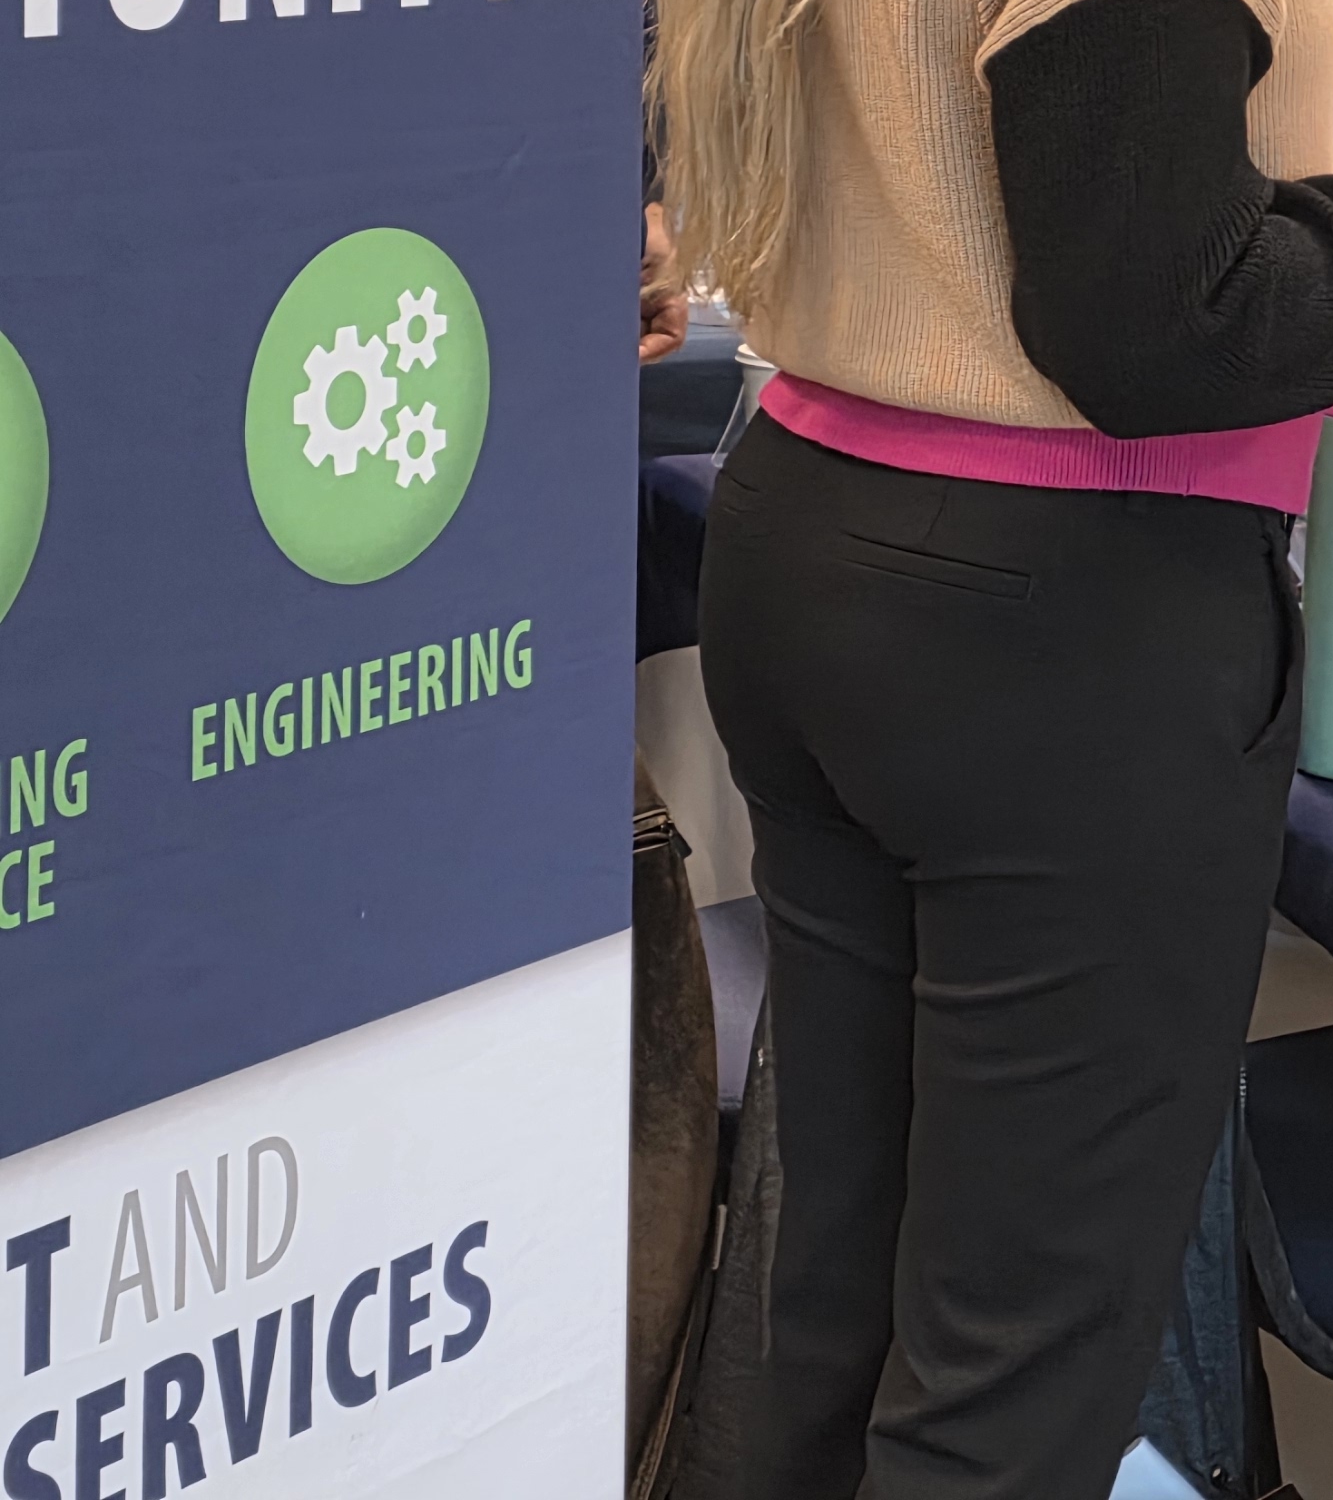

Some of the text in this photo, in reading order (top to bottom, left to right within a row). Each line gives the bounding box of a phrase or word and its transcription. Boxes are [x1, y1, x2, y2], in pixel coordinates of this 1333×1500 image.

[192, 619, 534, 782] ENGINEERING
[9, 738, 88, 834] NG
[0, 840, 55, 930] CE
[6, 1135, 300, 1376] T AND
[3, 1220, 491, 1500] SERVICES
